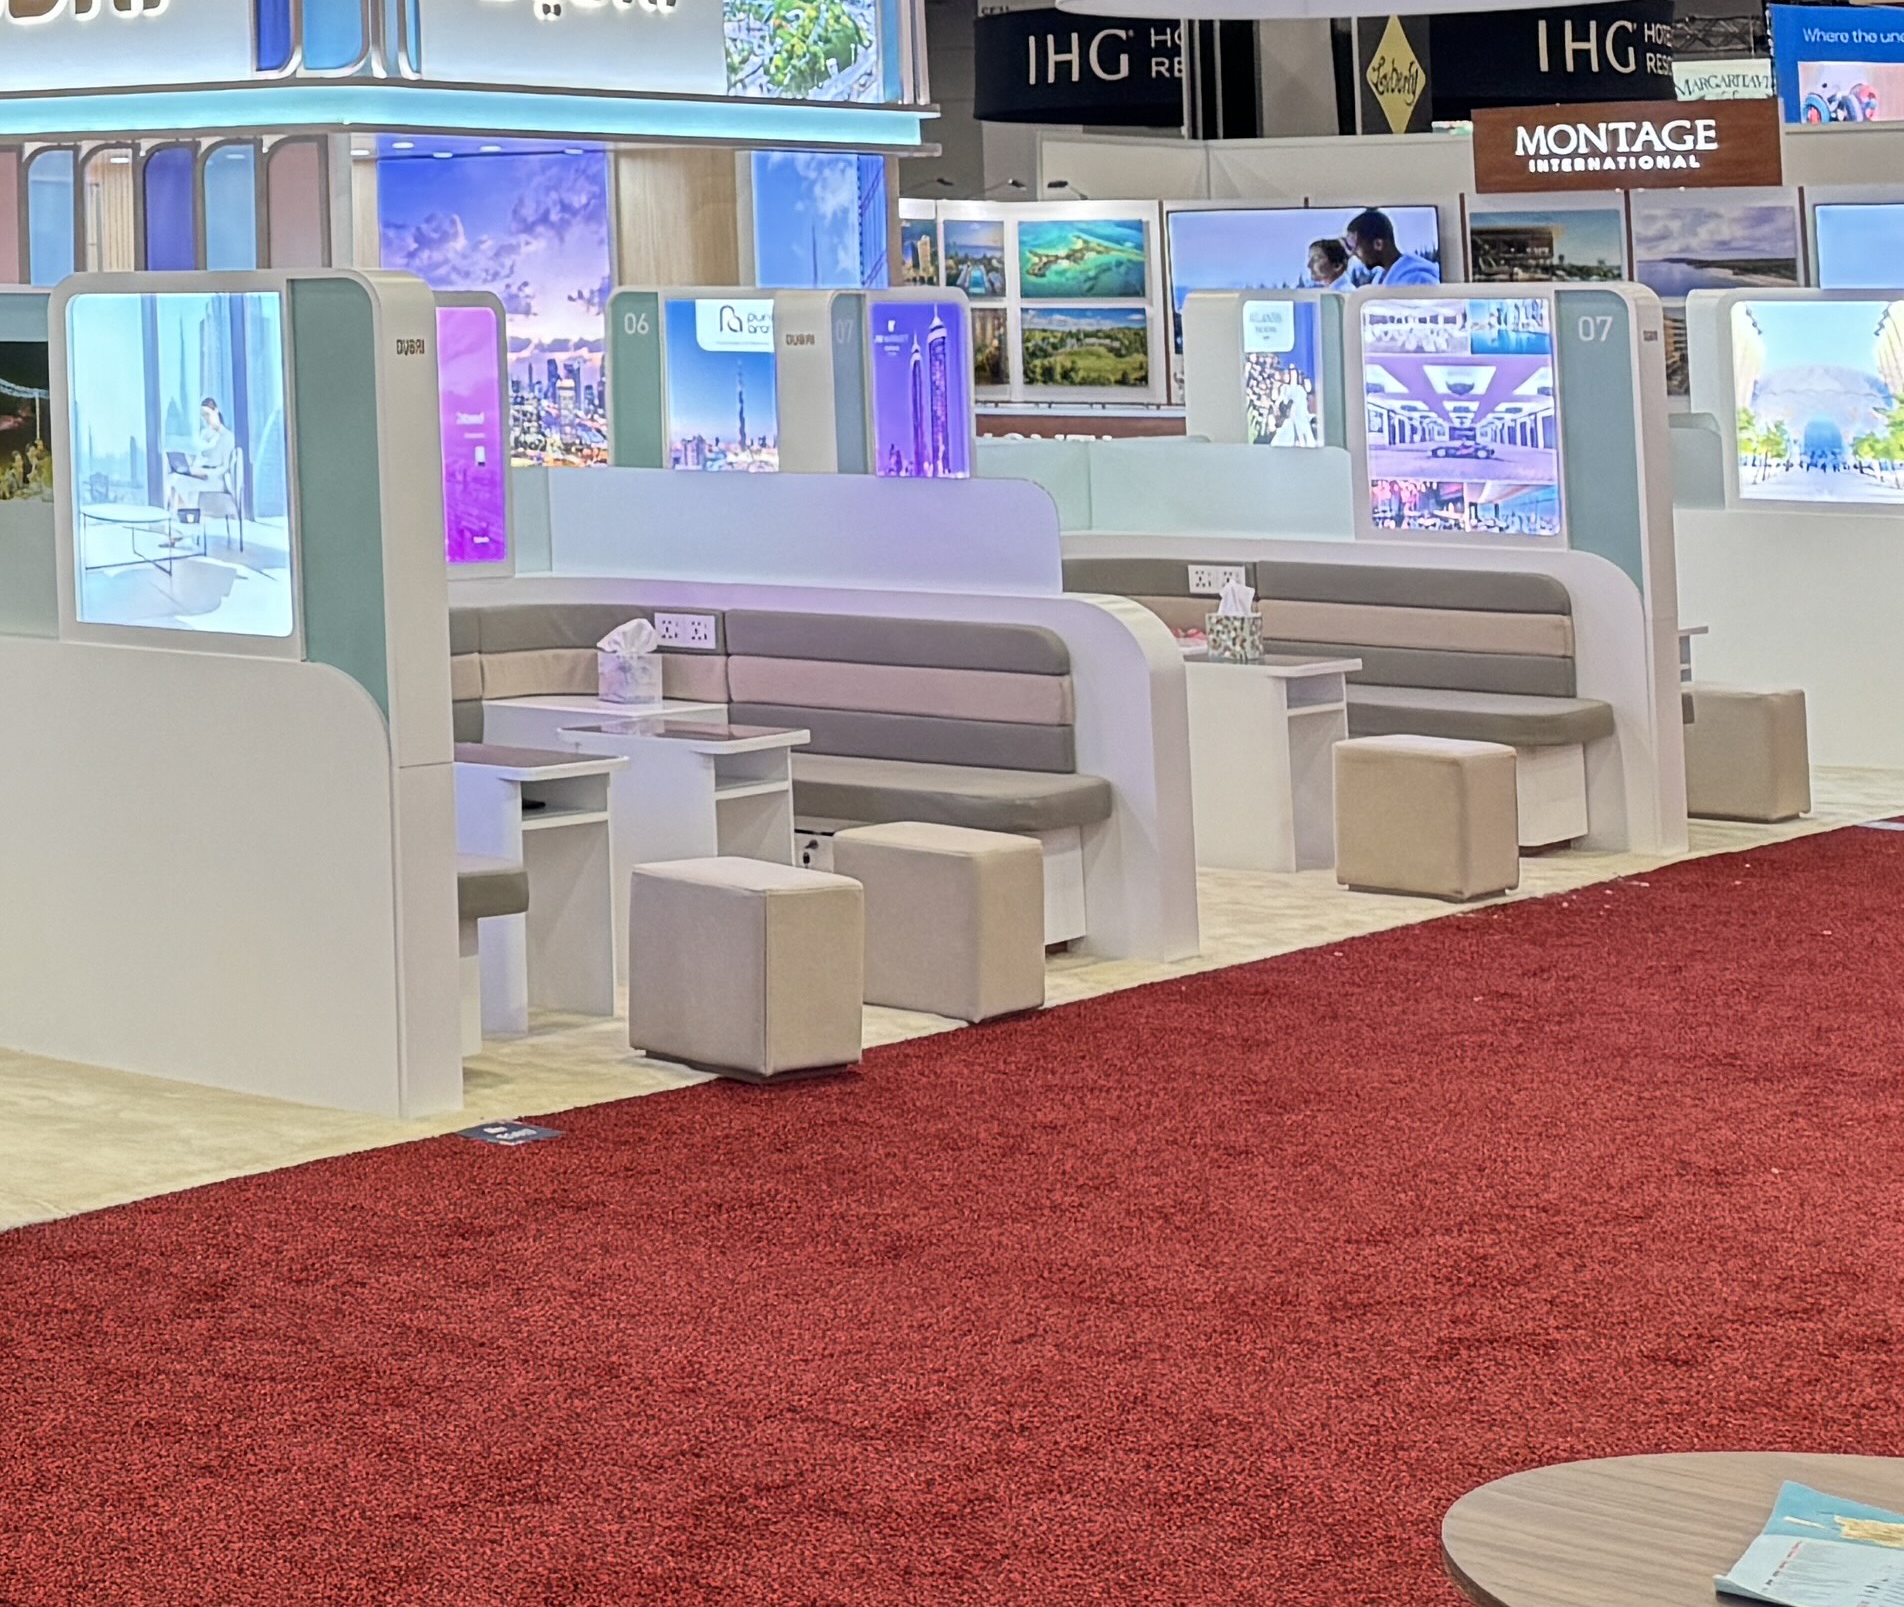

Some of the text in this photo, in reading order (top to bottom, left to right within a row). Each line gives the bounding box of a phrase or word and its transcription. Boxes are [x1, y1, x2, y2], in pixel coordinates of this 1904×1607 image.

[1538, 19, 1635, 74] IHG
[1803, 27, 1849, 44] Where
[1852, 28, 1879, 44] the
[1028, 29, 1130, 85] IHG
[1515, 119, 1719, 158] MONTAGE
[1529, 155, 1701, 174] INTERNATIONAL
[624, 312, 649, 335] 06
[1579, 316, 1613, 342] 07
